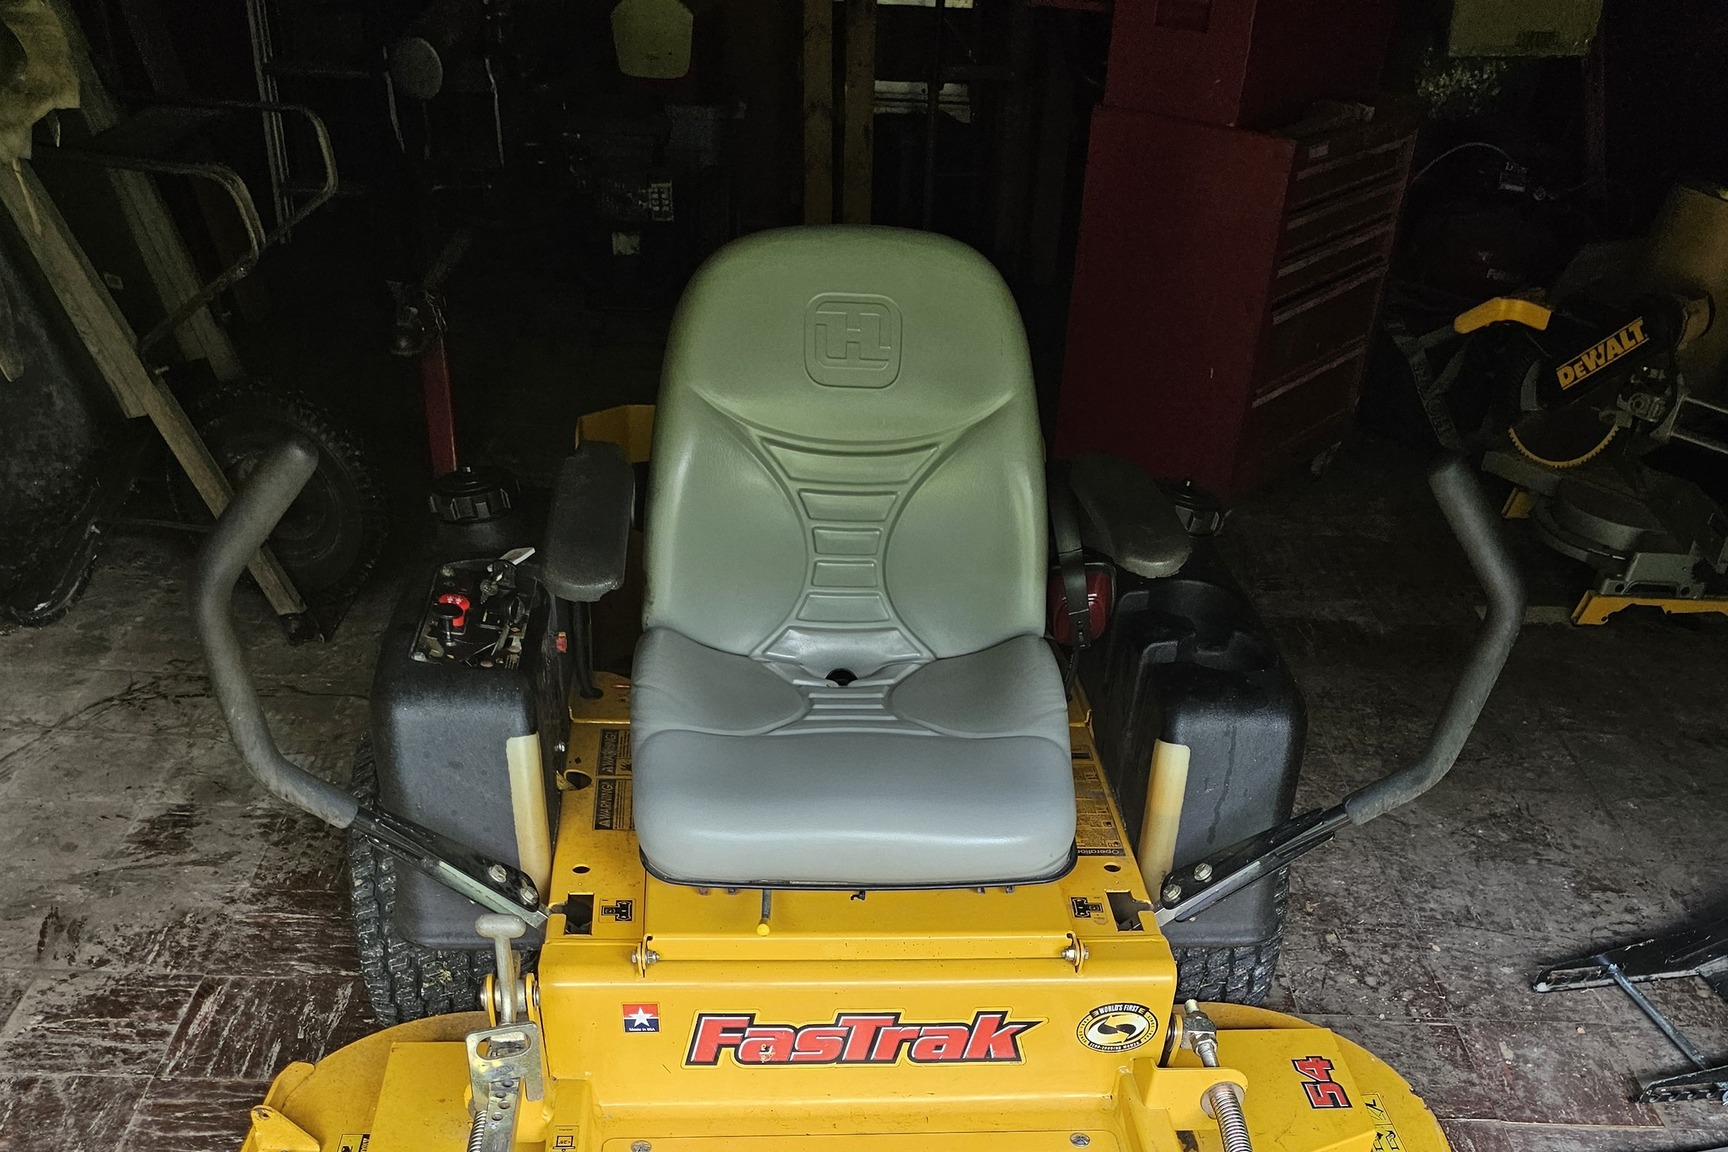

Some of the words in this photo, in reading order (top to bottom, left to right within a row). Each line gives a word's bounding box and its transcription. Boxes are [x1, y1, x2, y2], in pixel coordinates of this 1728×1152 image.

[1099, 1004, 1123, 1014] WORLD'S
[1123, 1004, 1139, 1012] FIRST
[686, 1011, 1040, 1065] FasTrak
[1291, 1056, 1353, 1109] 54
